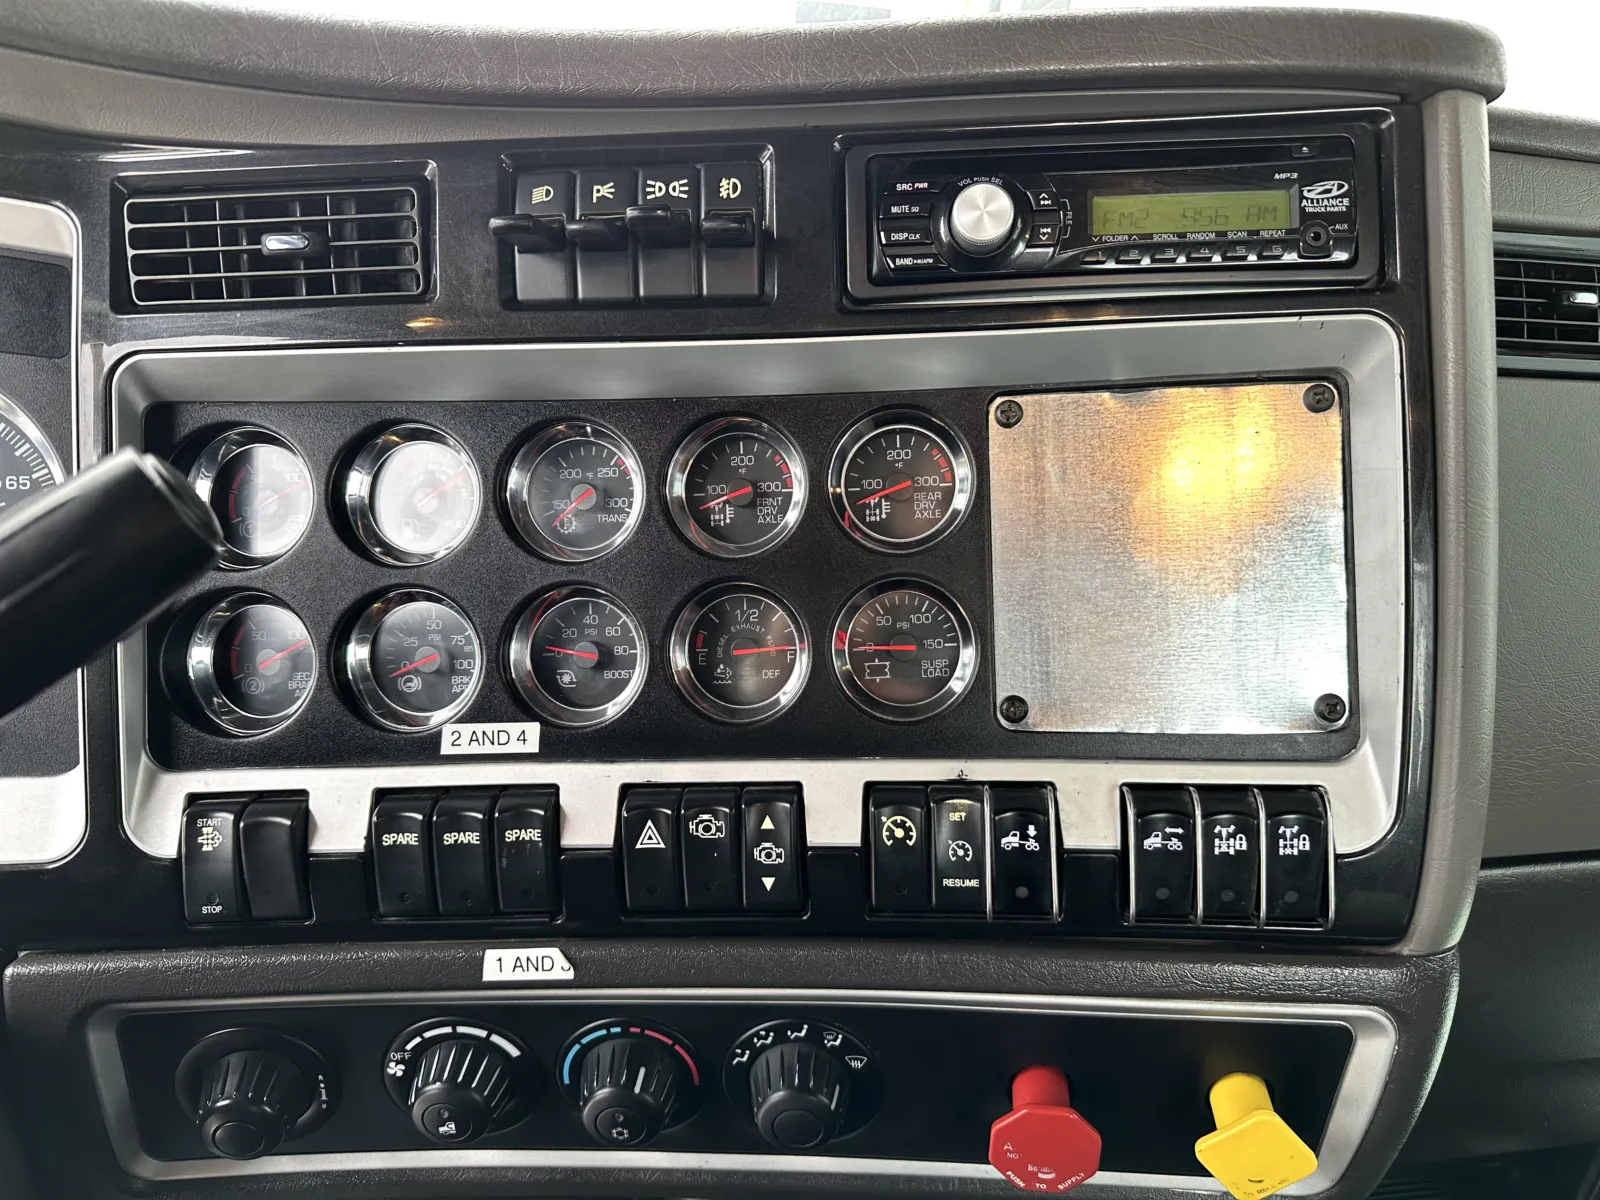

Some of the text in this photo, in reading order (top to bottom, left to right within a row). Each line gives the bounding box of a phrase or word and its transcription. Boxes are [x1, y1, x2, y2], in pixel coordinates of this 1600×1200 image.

[957, 177, 973, 187] VOL
[990, 176, 1004, 186] SEL
[896, 183, 913, 191] SRC
[1301, 198, 1350, 207] ALLIANCE
[891, 205, 910, 213] MUTE
[1102, 208, 1149, 228] FM2
[1246, 204, 1279, 223] AM
[891, 232, 908, 240] DISP
[1186, 232, 1216, 240] RANDOM
[1129, 249, 1139, 257] 2
[1236, 245, 1246, 253] 5
[895, 257, 914, 266] BAND
[886, 449, 911, 460] 200
[730, 455, 755, 466] 200
[559, 468, 582, 479] 200
[597, 467, 619, 478] 250
[5, 475, 31, 490] 65
[860, 479, 883, 489] 100
[914, 475, 939, 487] 300
[706, 484, 727, 495] 100
[757, 482, 782, 492] 300
[913, 491, 942, 501] REAR
[552, 499, 570, 510] 150
[605, 498, 628, 508] 300
[757, 497, 783, 506] FRNT
[914, 501, 936, 510] DRV
[757, 506, 778, 515] DRV
[914, 509, 942, 519] AXLE
[597, 514, 628, 523] TRANS
[757, 515, 783, 524] AXLE
[583, 614, 599, 625] 40
[734, 609, 759, 623] 1/2
[876, 615, 892, 626] 50
[909, 613, 932, 624] 100
[426, 620, 442, 630] 50
[896, 621, 910, 629] PSI
[251, 631, 267, 641] 50
[287, 630, 307, 640] 100
[562, 628, 577, 638] 20
[605, 626, 621, 636] 60
[403, 636, 418, 647] 25
[450, 635, 465, 645] 75
[716, 634, 730, 658] DIESEL
[730, 624, 766, 634] EXHAUST
[922, 638, 944, 649] 150
[613, 645, 629, 655] 80
[866, 642, 874, 652] 0
[698, 653, 707, 665] E
[787, 651, 795, 663] F
[244, 663, 253, 673] 0
[401, 661, 410, 670] 0
[453, 659, 474, 669] 100
[921, 659, 949, 669] SUSP
[292, 672, 311, 681] SEC
[603, 670, 634, 679] BOOST
[762, 669, 780, 679] DEF
[921, 668, 950, 678] LOAD
[451, 676, 471, 685] BRK
[450, 729, 528, 747] 2 AND 4
[949, 812, 967, 821] SET
[196, 818, 222, 827] START
[382, 833, 419, 846] SPARE
[443, 832, 480, 845] SPARE
[505, 829, 542, 842] SPARE
[942, 878, 980, 888] RESUME
[201, 905, 223, 914] STOP
[496, 956, 503, 973] 1
[512, 955, 555, 973] AND
[390, 1052, 412, 1061] OFF
[1005, 1170, 1026, 1188] PUSH
[1057, 1172, 1085, 1190] SUPPLY
